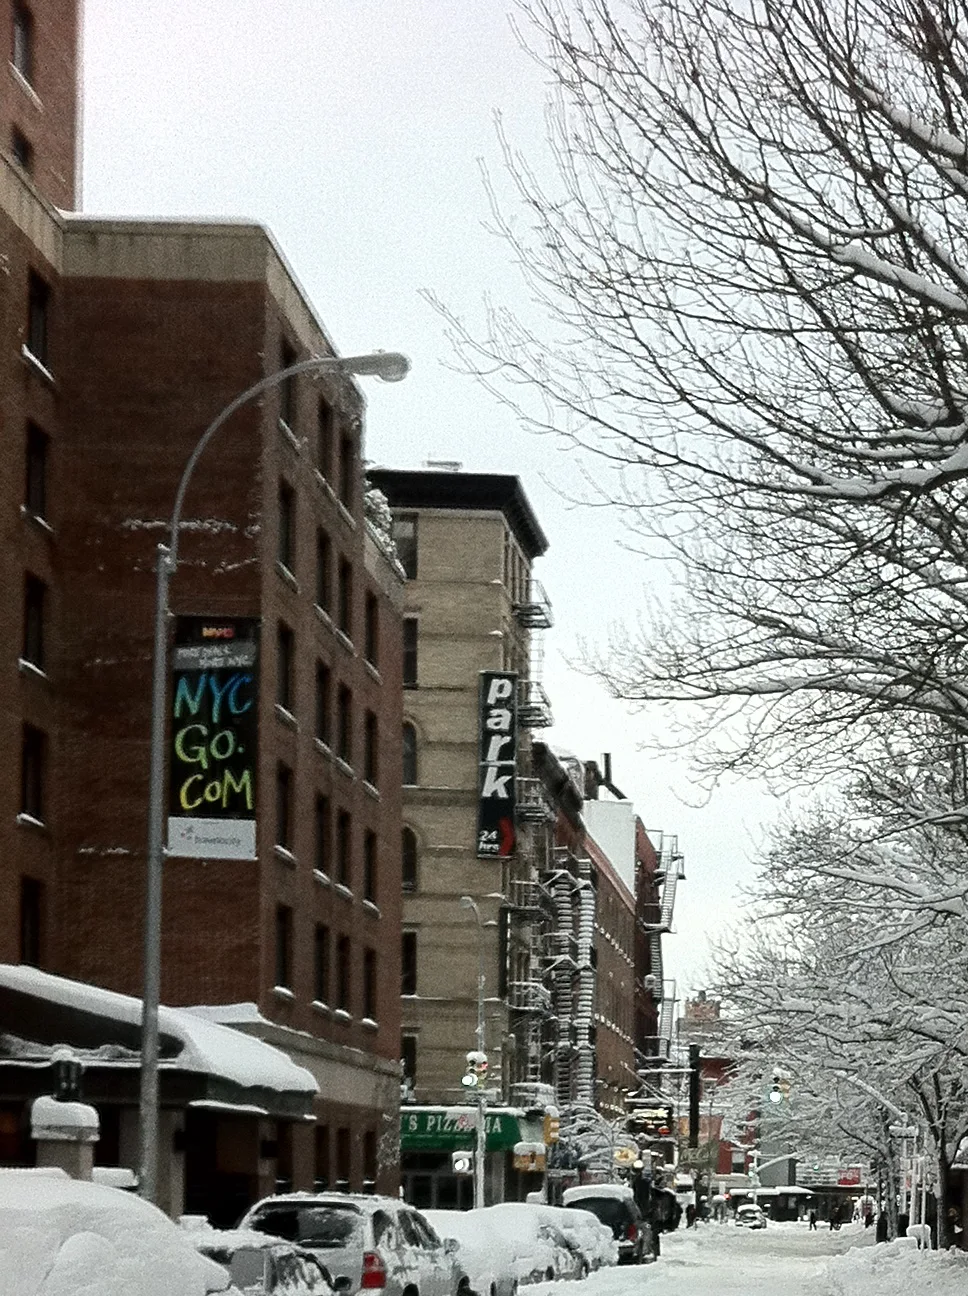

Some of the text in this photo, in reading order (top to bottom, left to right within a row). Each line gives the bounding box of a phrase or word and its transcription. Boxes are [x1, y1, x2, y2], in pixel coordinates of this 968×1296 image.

[174, 673, 252, 723] NYC
[481, 678, 513, 799] park
[479, 830, 498, 841] 24
[426, 1115, 502, 1133] PIZZIA
